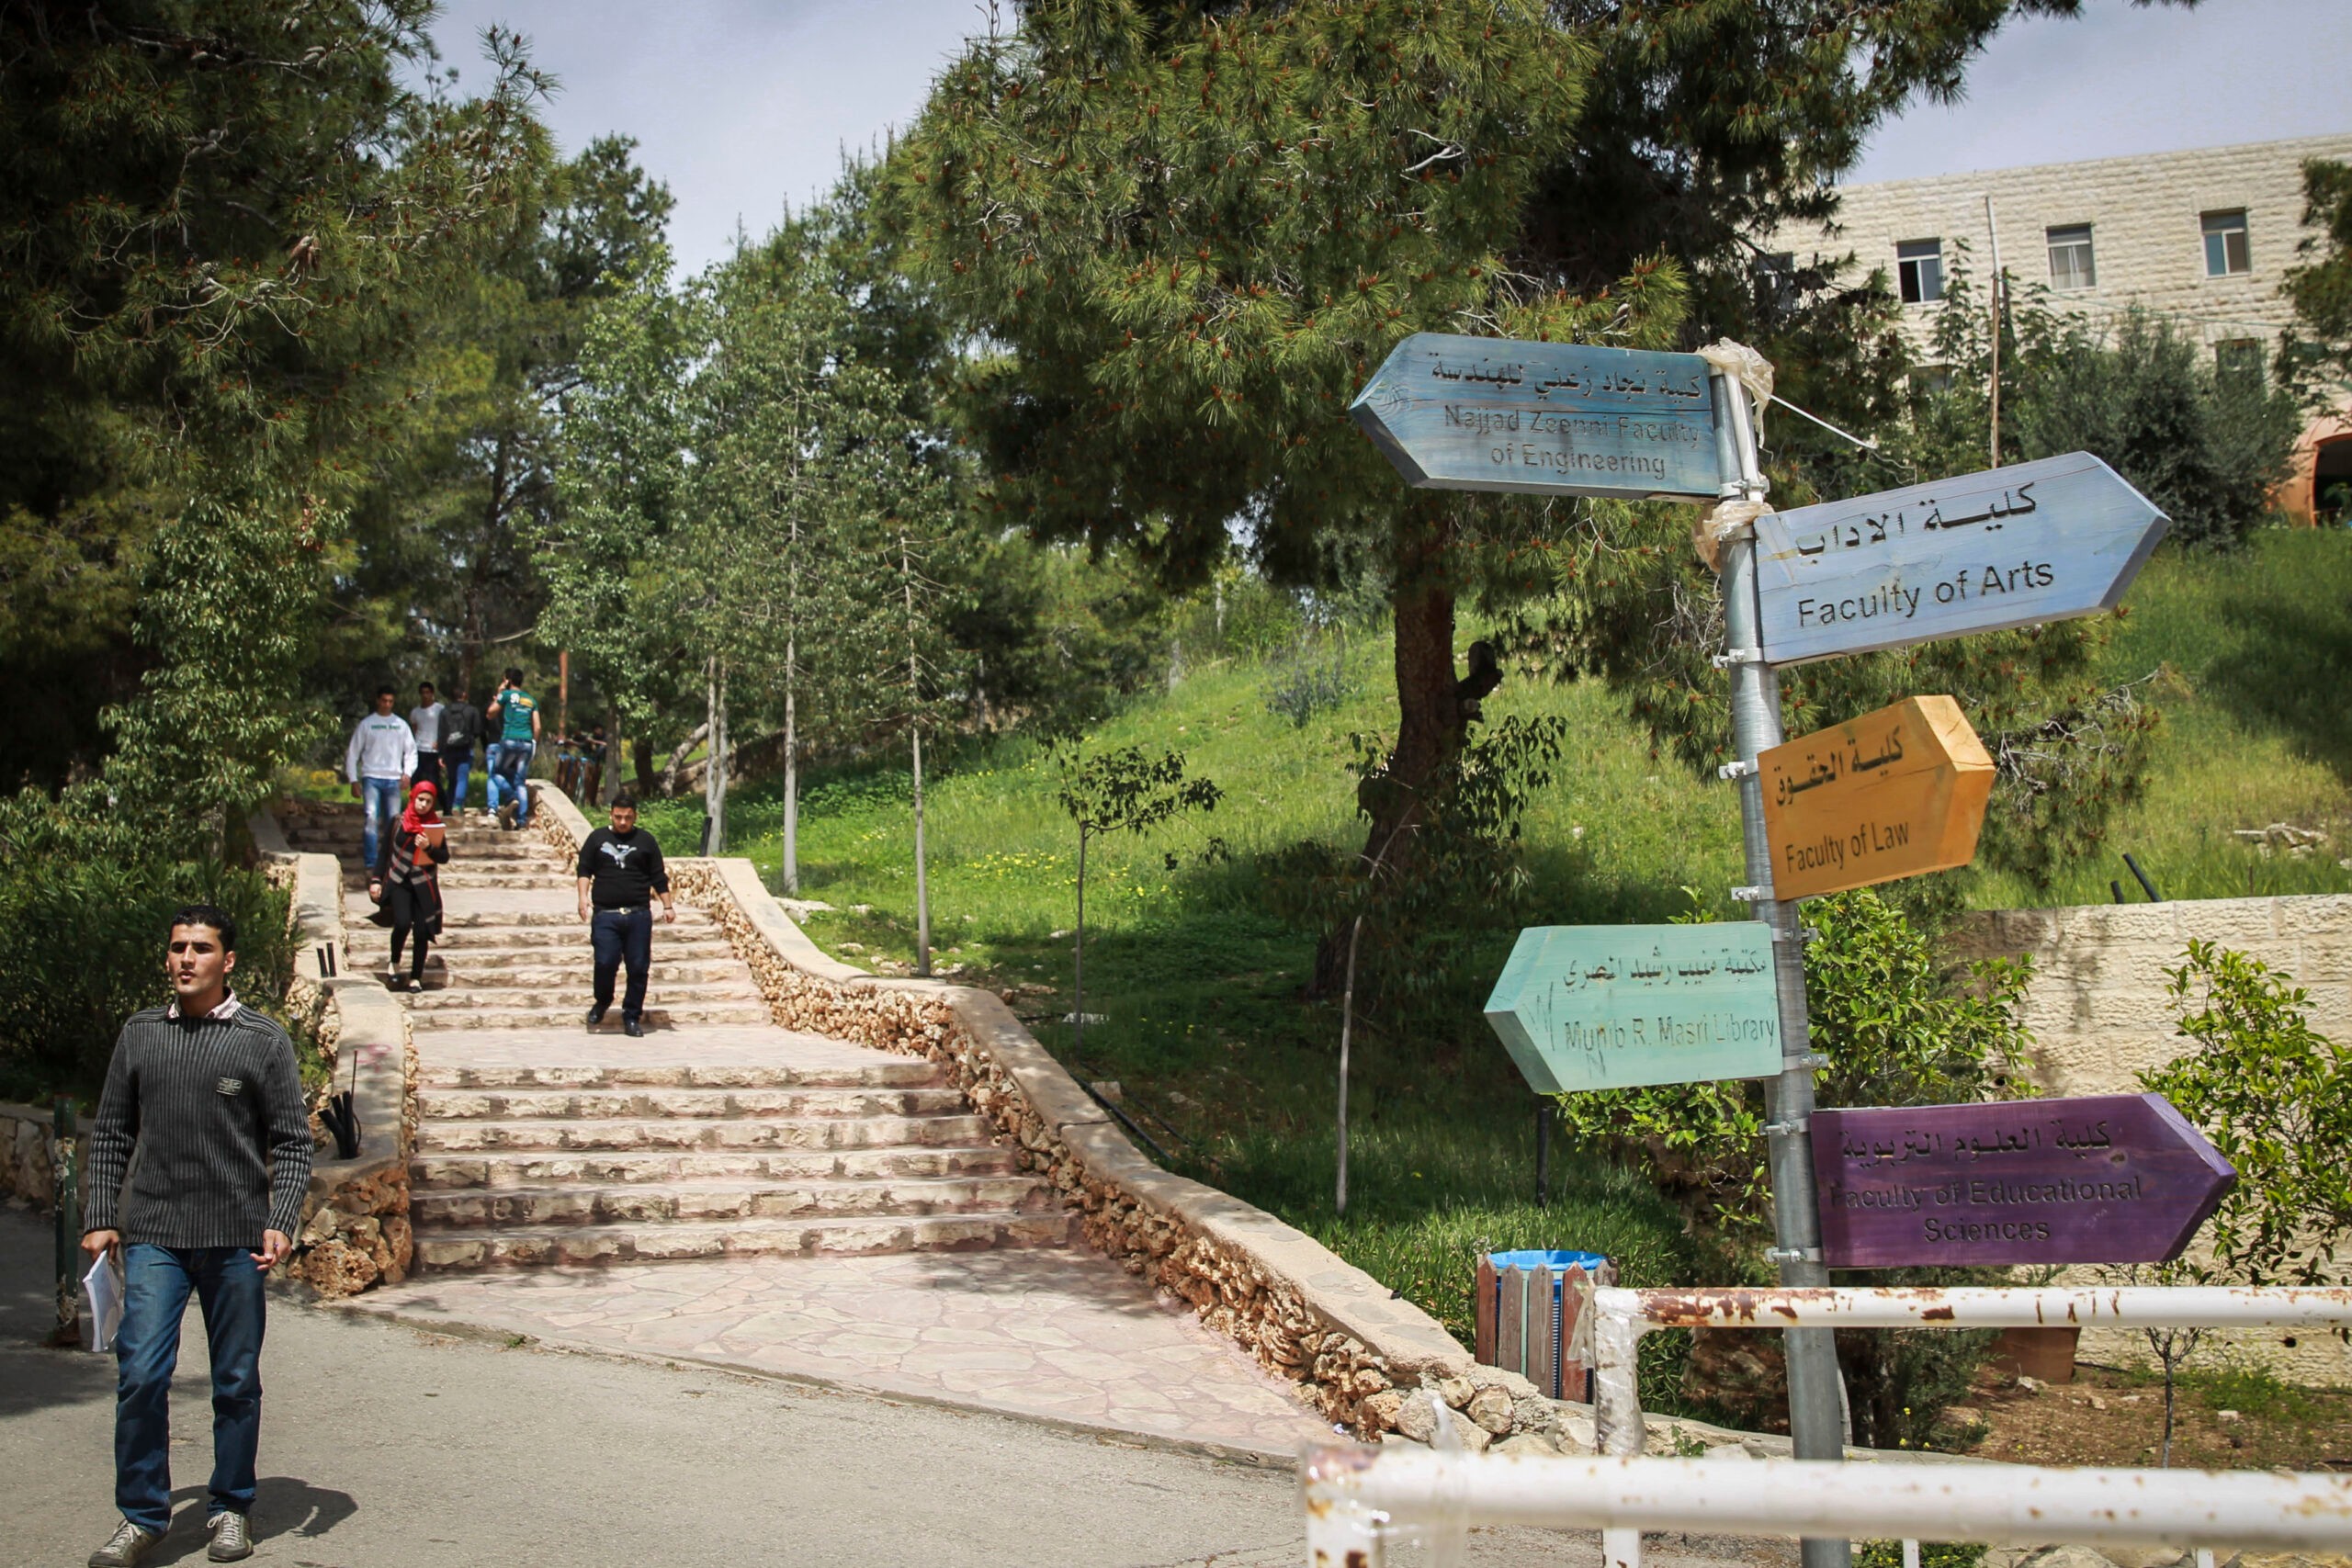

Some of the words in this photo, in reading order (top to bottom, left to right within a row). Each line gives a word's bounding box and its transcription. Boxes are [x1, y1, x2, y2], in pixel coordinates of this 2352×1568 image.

[1444, 404, 1521, 435] Najjad
[1617, 416, 1701, 448] Faculty
[1490, 442, 1515, 465] of
[1522, 444, 1667, 481] Engineering
[1918, 480, 2037, 532] كلية
[1797, 577, 1921, 628] Faculty
[1935, 570, 1969, 605] of
[1980, 561, 2054, 597] Arts
[1847, 725, 1905, 776] كلية
[1773, 749, 1845, 807] الحقوق
[1785, 834, 1845, 874] Faculty
[1849, 823, 1869, 858] of
[1871, 821, 1909, 852] Law
[1564, 1018, 1626, 1052] Munib
[1632, 1017, 1653, 1047] R.
[1657, 1015, 1709, 1046] Masri
[1713, 1012, 1775, 1047] Library
[1838, 1130, 1942, 1168] التربوية
[1953, 1128, 2042, 1162] العلوم
[2051, 1119, 2113, 1158] كلية
[1828, 1181, 1924, 1213] Faculty
[1934, 1181, 1961, 1206] of
[1968, 1176, 2143, 1206] Educational
[1924, 1218, 2052, 1243] Sciences
